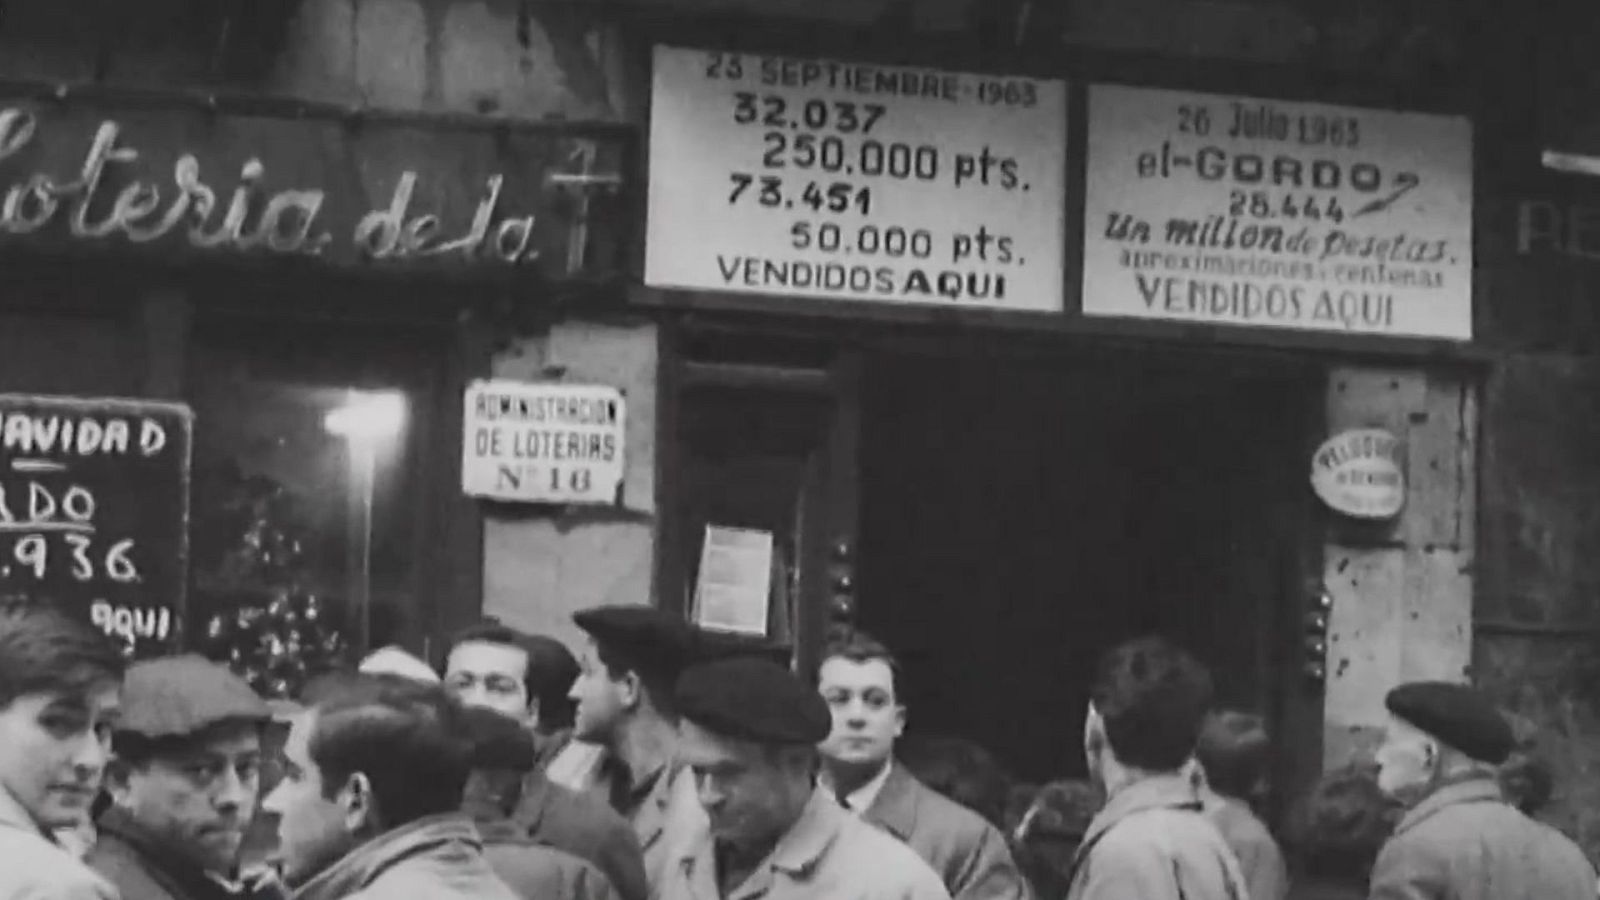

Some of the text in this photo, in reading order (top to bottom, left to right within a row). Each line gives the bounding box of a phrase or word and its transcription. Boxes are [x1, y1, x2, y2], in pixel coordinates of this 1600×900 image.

[733, 91, 887, 133] 32.037
[1228, 103, 1290, 142] Julio
[762, 132, 1031, 192] 250.000 pts.
[727, 171, 872, 216] 73.451
[1229, 189, 1345, 224] 28.444
[790, 221, 1026, 267] 50.000 pts.
[1105, 211, 1152, 244] Un
[1164, 215, 1285, 254] millon
[717, 256, 1007, 301] VENDIDOS AQUI
[1135, 272, 1394, 330] VENDIDOS AQUI
[0, 412, 166, 456] AVIDAD
[475, 427, 616, 463] DE LOTERIAS
